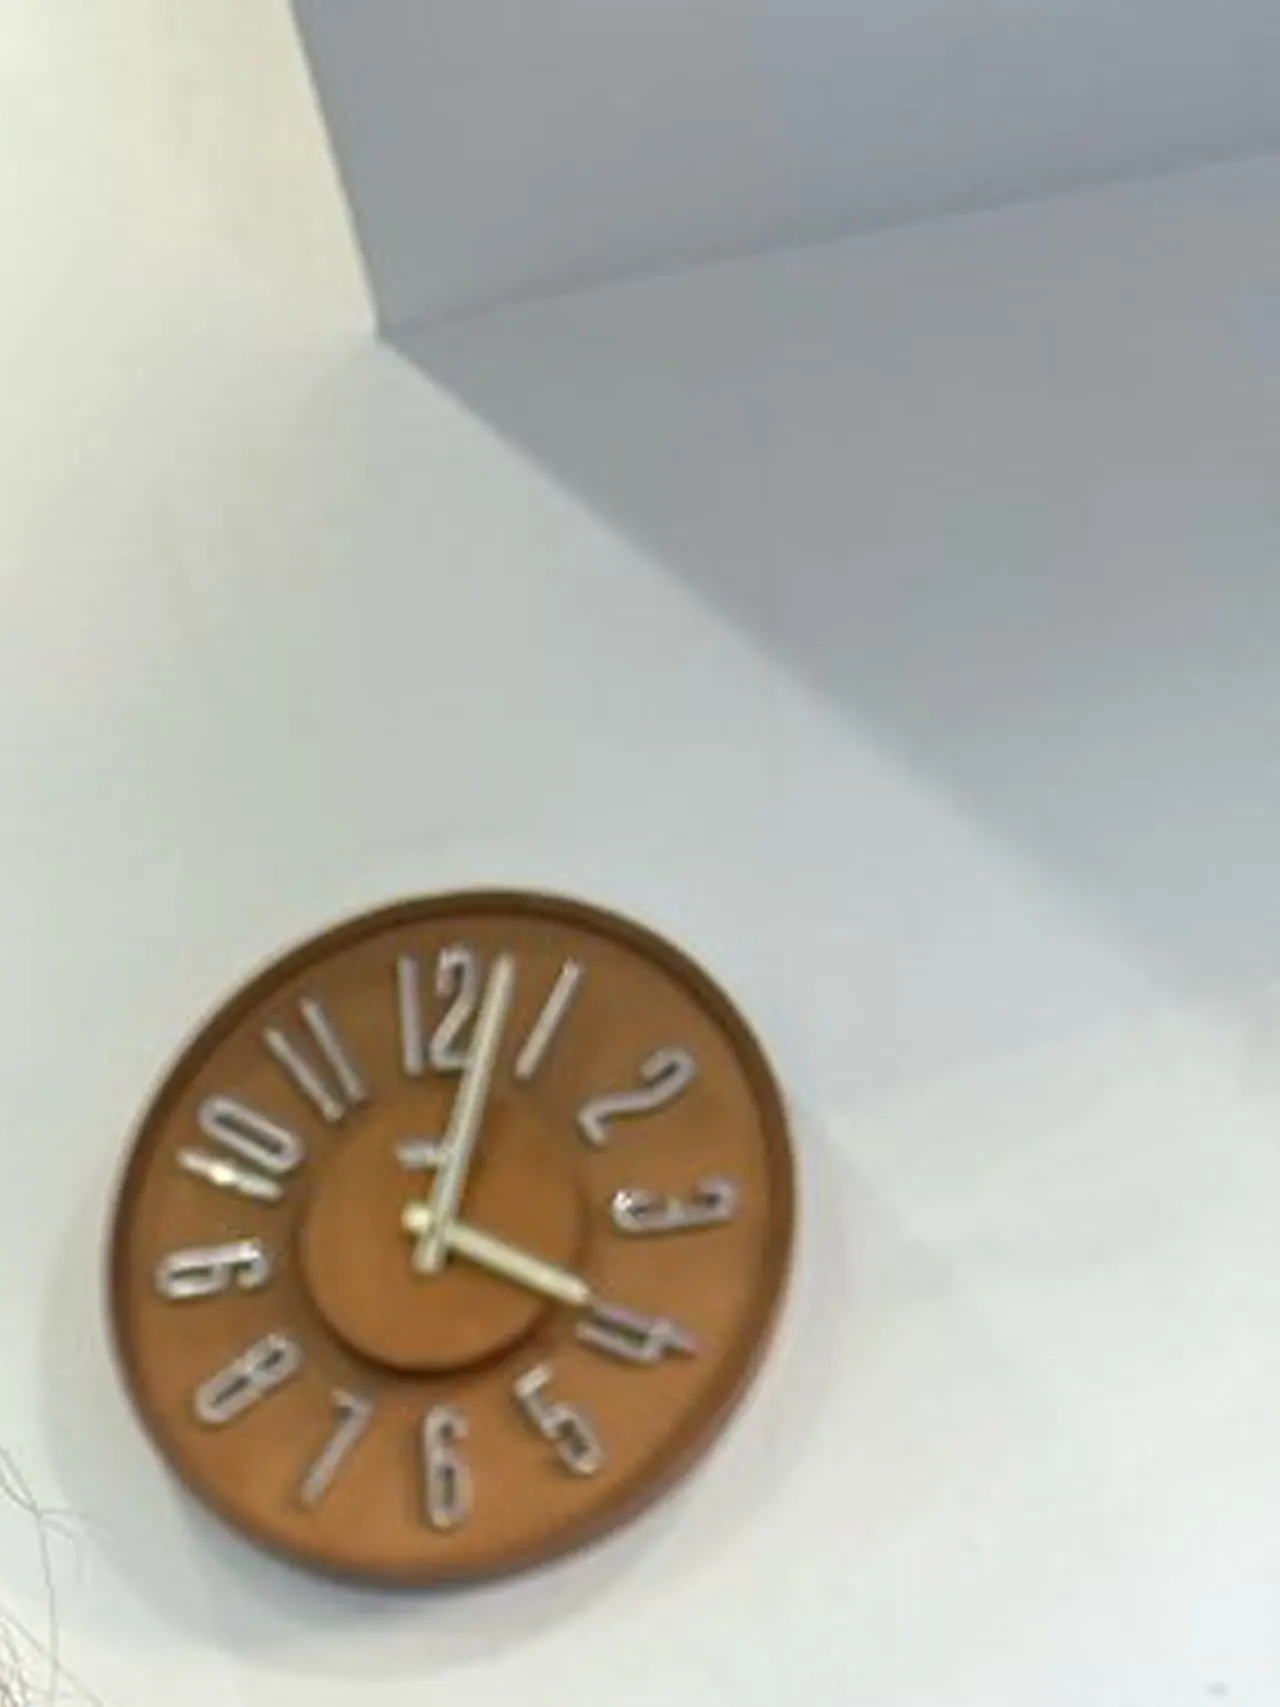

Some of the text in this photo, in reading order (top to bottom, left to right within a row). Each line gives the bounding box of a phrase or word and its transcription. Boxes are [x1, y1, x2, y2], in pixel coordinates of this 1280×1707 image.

[265, 1000, 366, 1121] 11
[395, 942, 477, 1077] 12
[514, 960, 586, 1081] 1
[178, 1096, 303, 1200] 10
[576, 1045, 699, 1148] 2
[613, 1179, 737, 1231] 3
[160, 1239, 269, 1297] 9
[196, 1333, 300, 1423] 8
[577, 1303, 700, 1361] 4
[303, 1390, 371, 1503] 7
[424, 1405, 470, 1529] 6
[516, 1365, 605, 1474] 5
